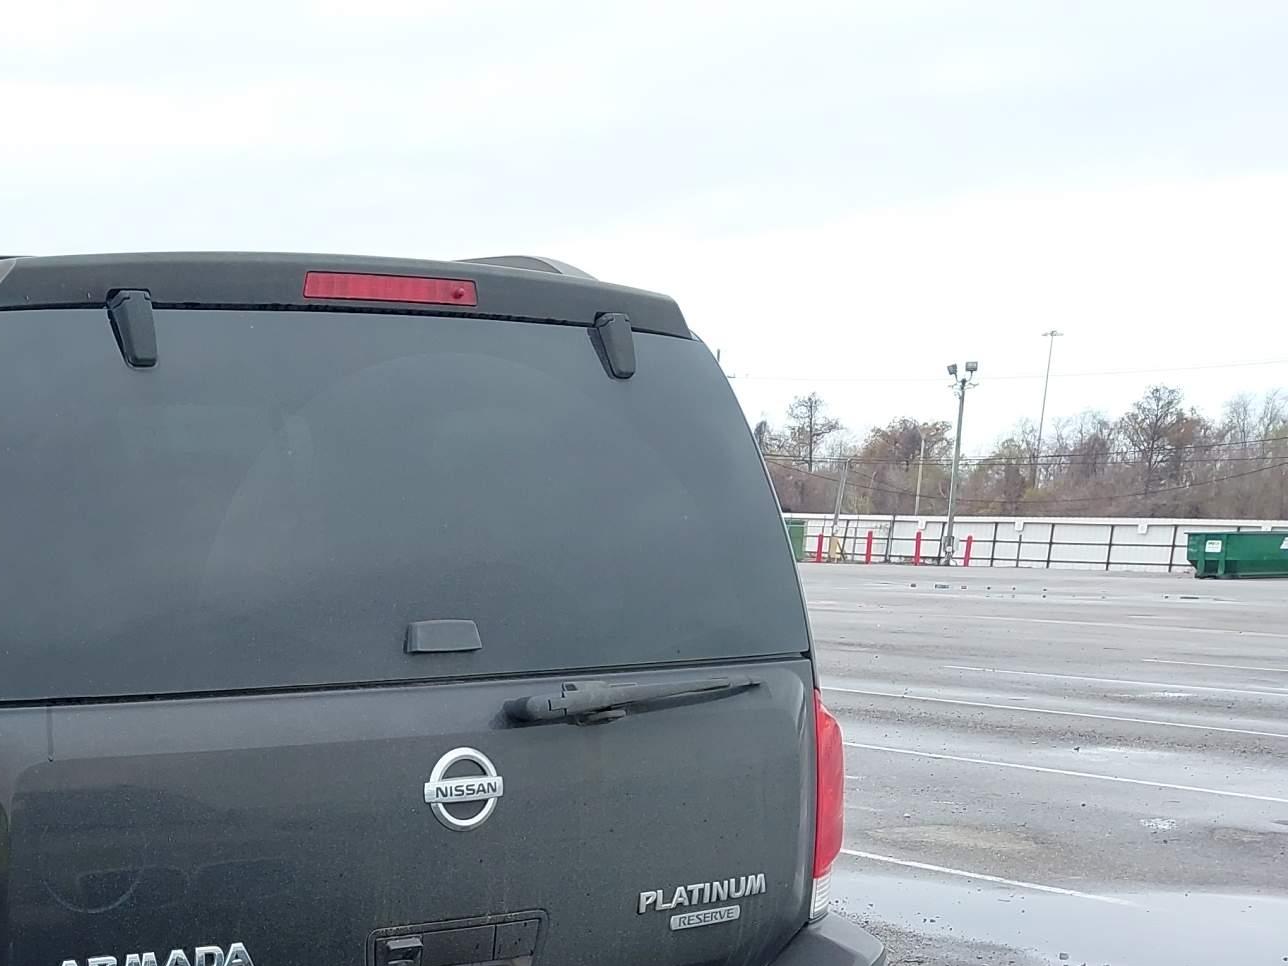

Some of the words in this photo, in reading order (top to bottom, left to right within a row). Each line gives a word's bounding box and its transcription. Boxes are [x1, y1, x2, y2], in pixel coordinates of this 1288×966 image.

[435, 781, 497, 798] NISSAN
[638, 873, 766, 914] PLATINUM
[678, 908, 734, 927] RESERVE
